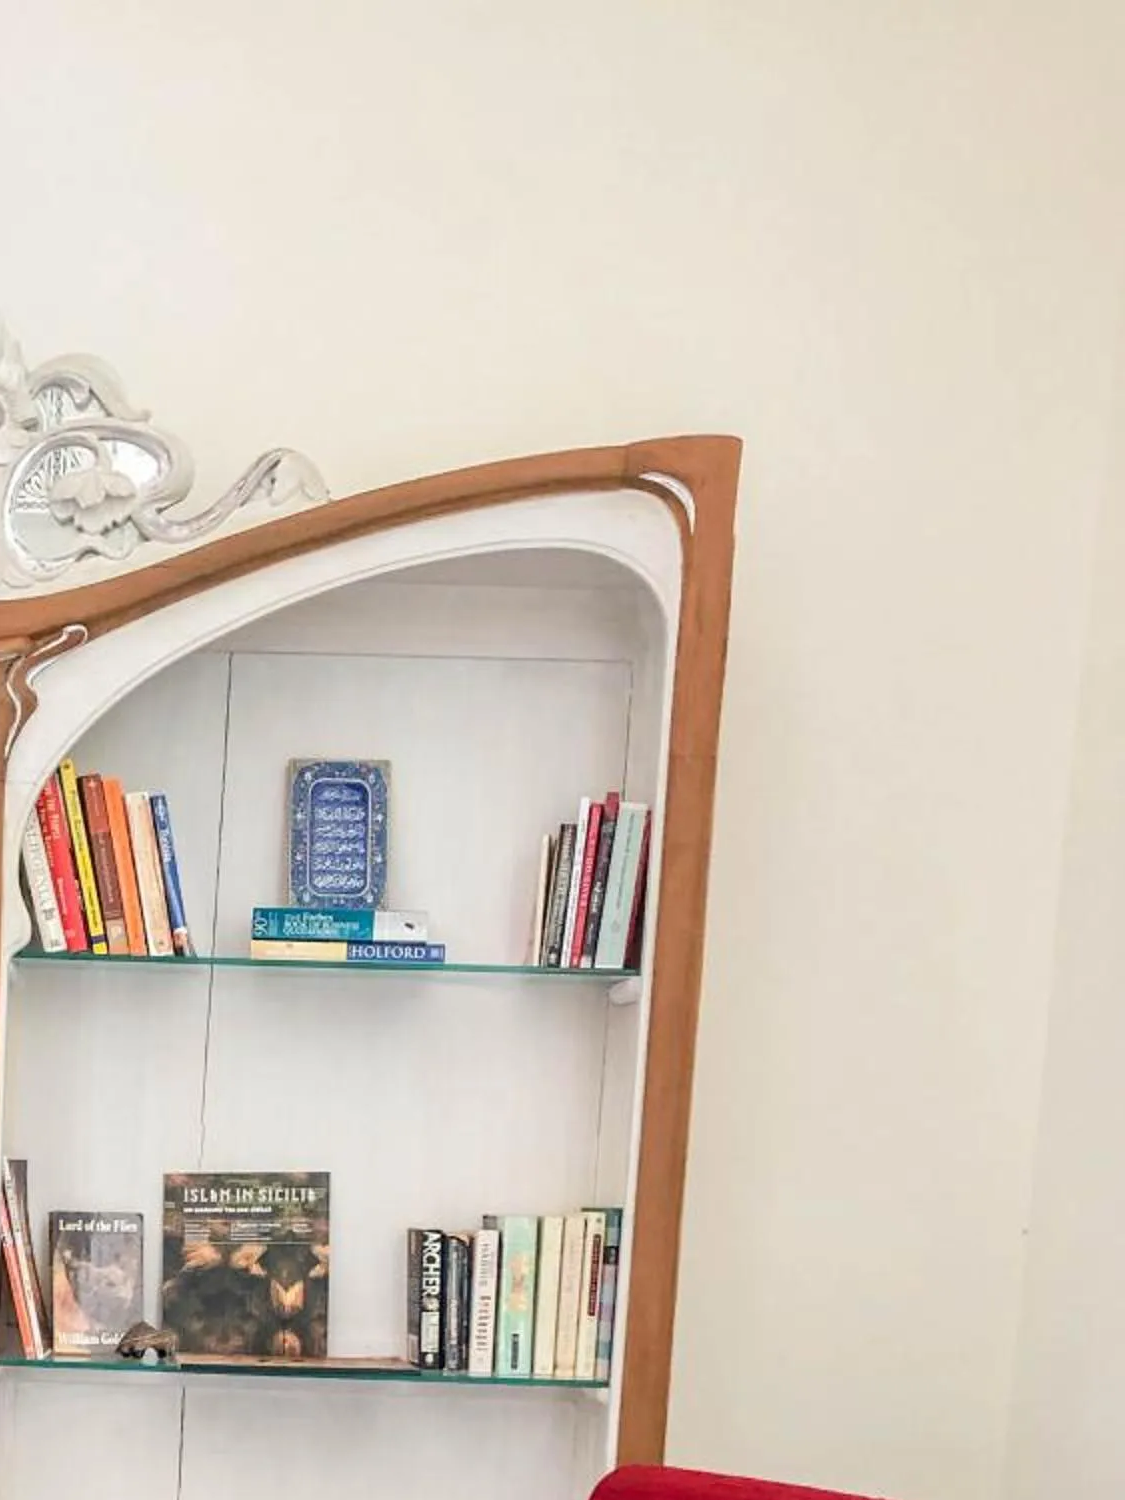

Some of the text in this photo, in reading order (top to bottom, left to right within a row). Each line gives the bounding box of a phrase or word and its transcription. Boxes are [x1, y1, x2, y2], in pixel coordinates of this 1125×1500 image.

[351, 944, 426, 959] HOLFORD
[184, 1188, 231, 1203] ISLAM
[236, 1188, 253, 1203] IN
[59, 1219, 139, 1233] Lord of the Flies
[421, 1231, 442, 1296] ARCHER
